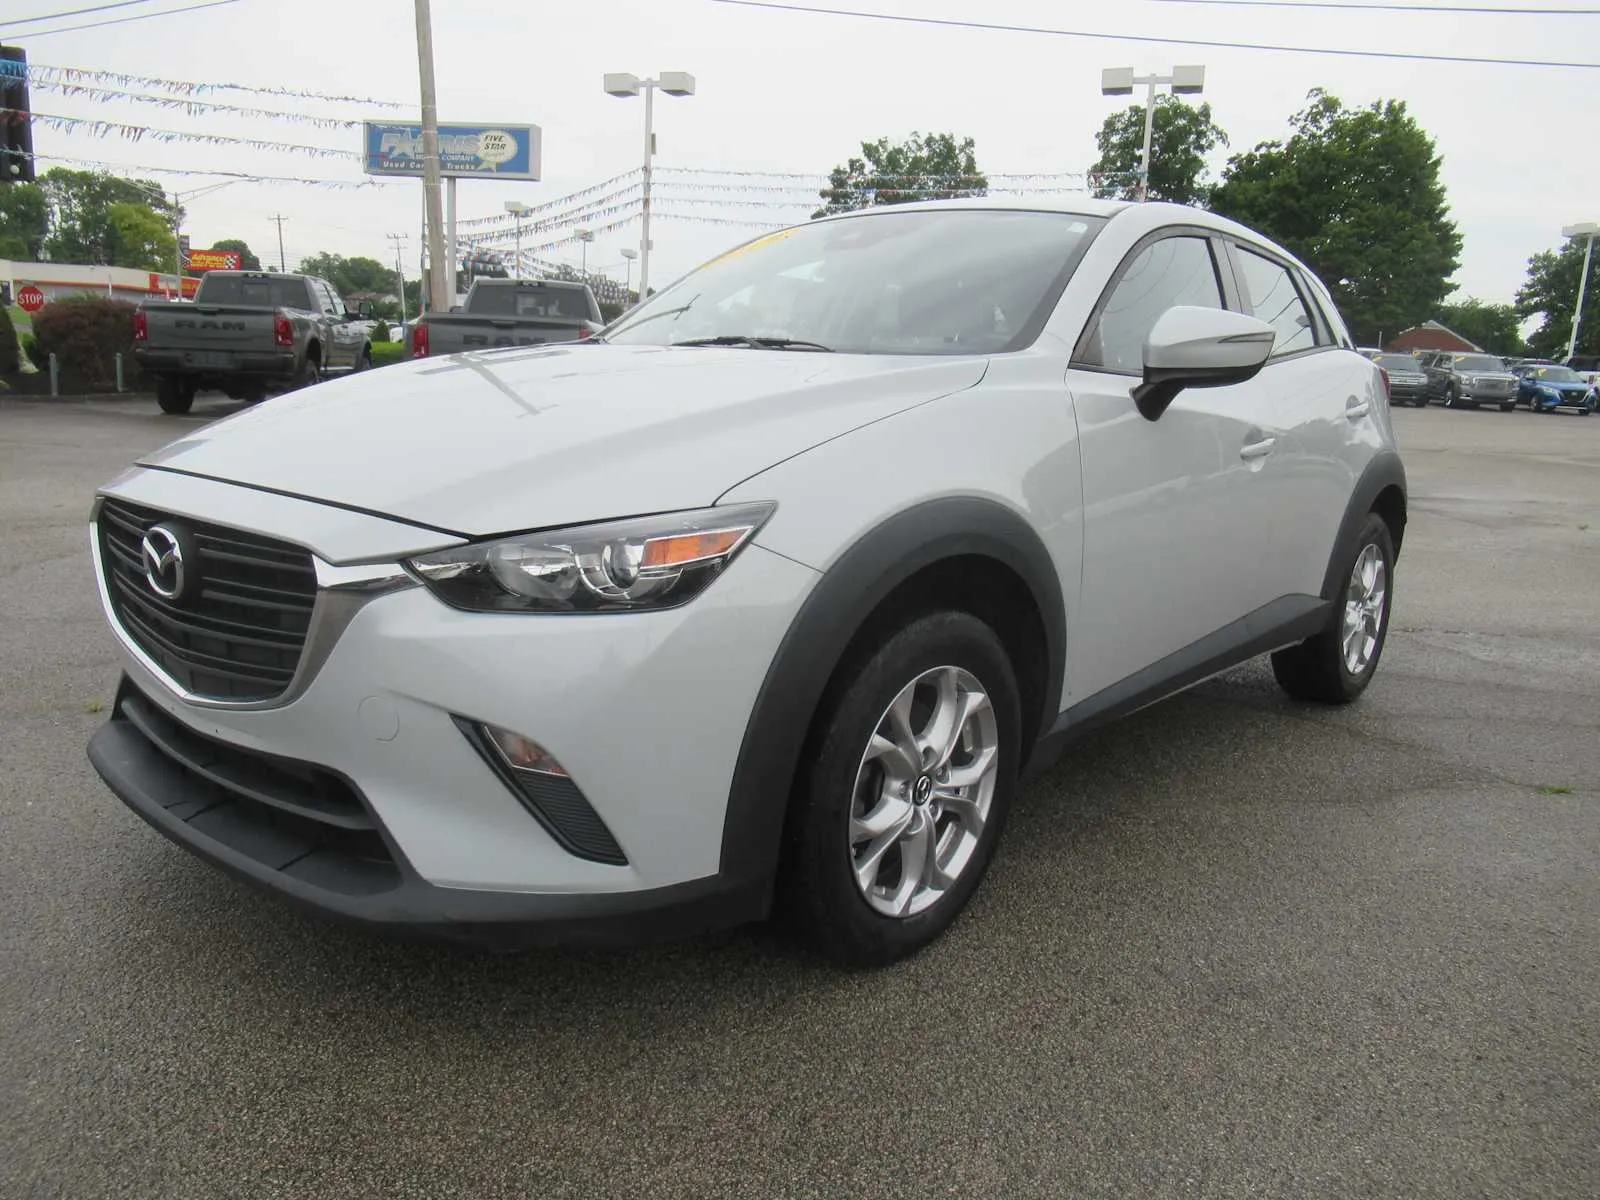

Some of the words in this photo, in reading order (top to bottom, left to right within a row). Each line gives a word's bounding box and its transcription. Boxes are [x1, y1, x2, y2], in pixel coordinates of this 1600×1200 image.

[484, 134, 505, 142] FIVE
[484, 142, 507, 151] STAR
[383, 160, 405, 168] Used
[18, 293, 42, 305] STOP
[174, 319, 246, 332] RAM
